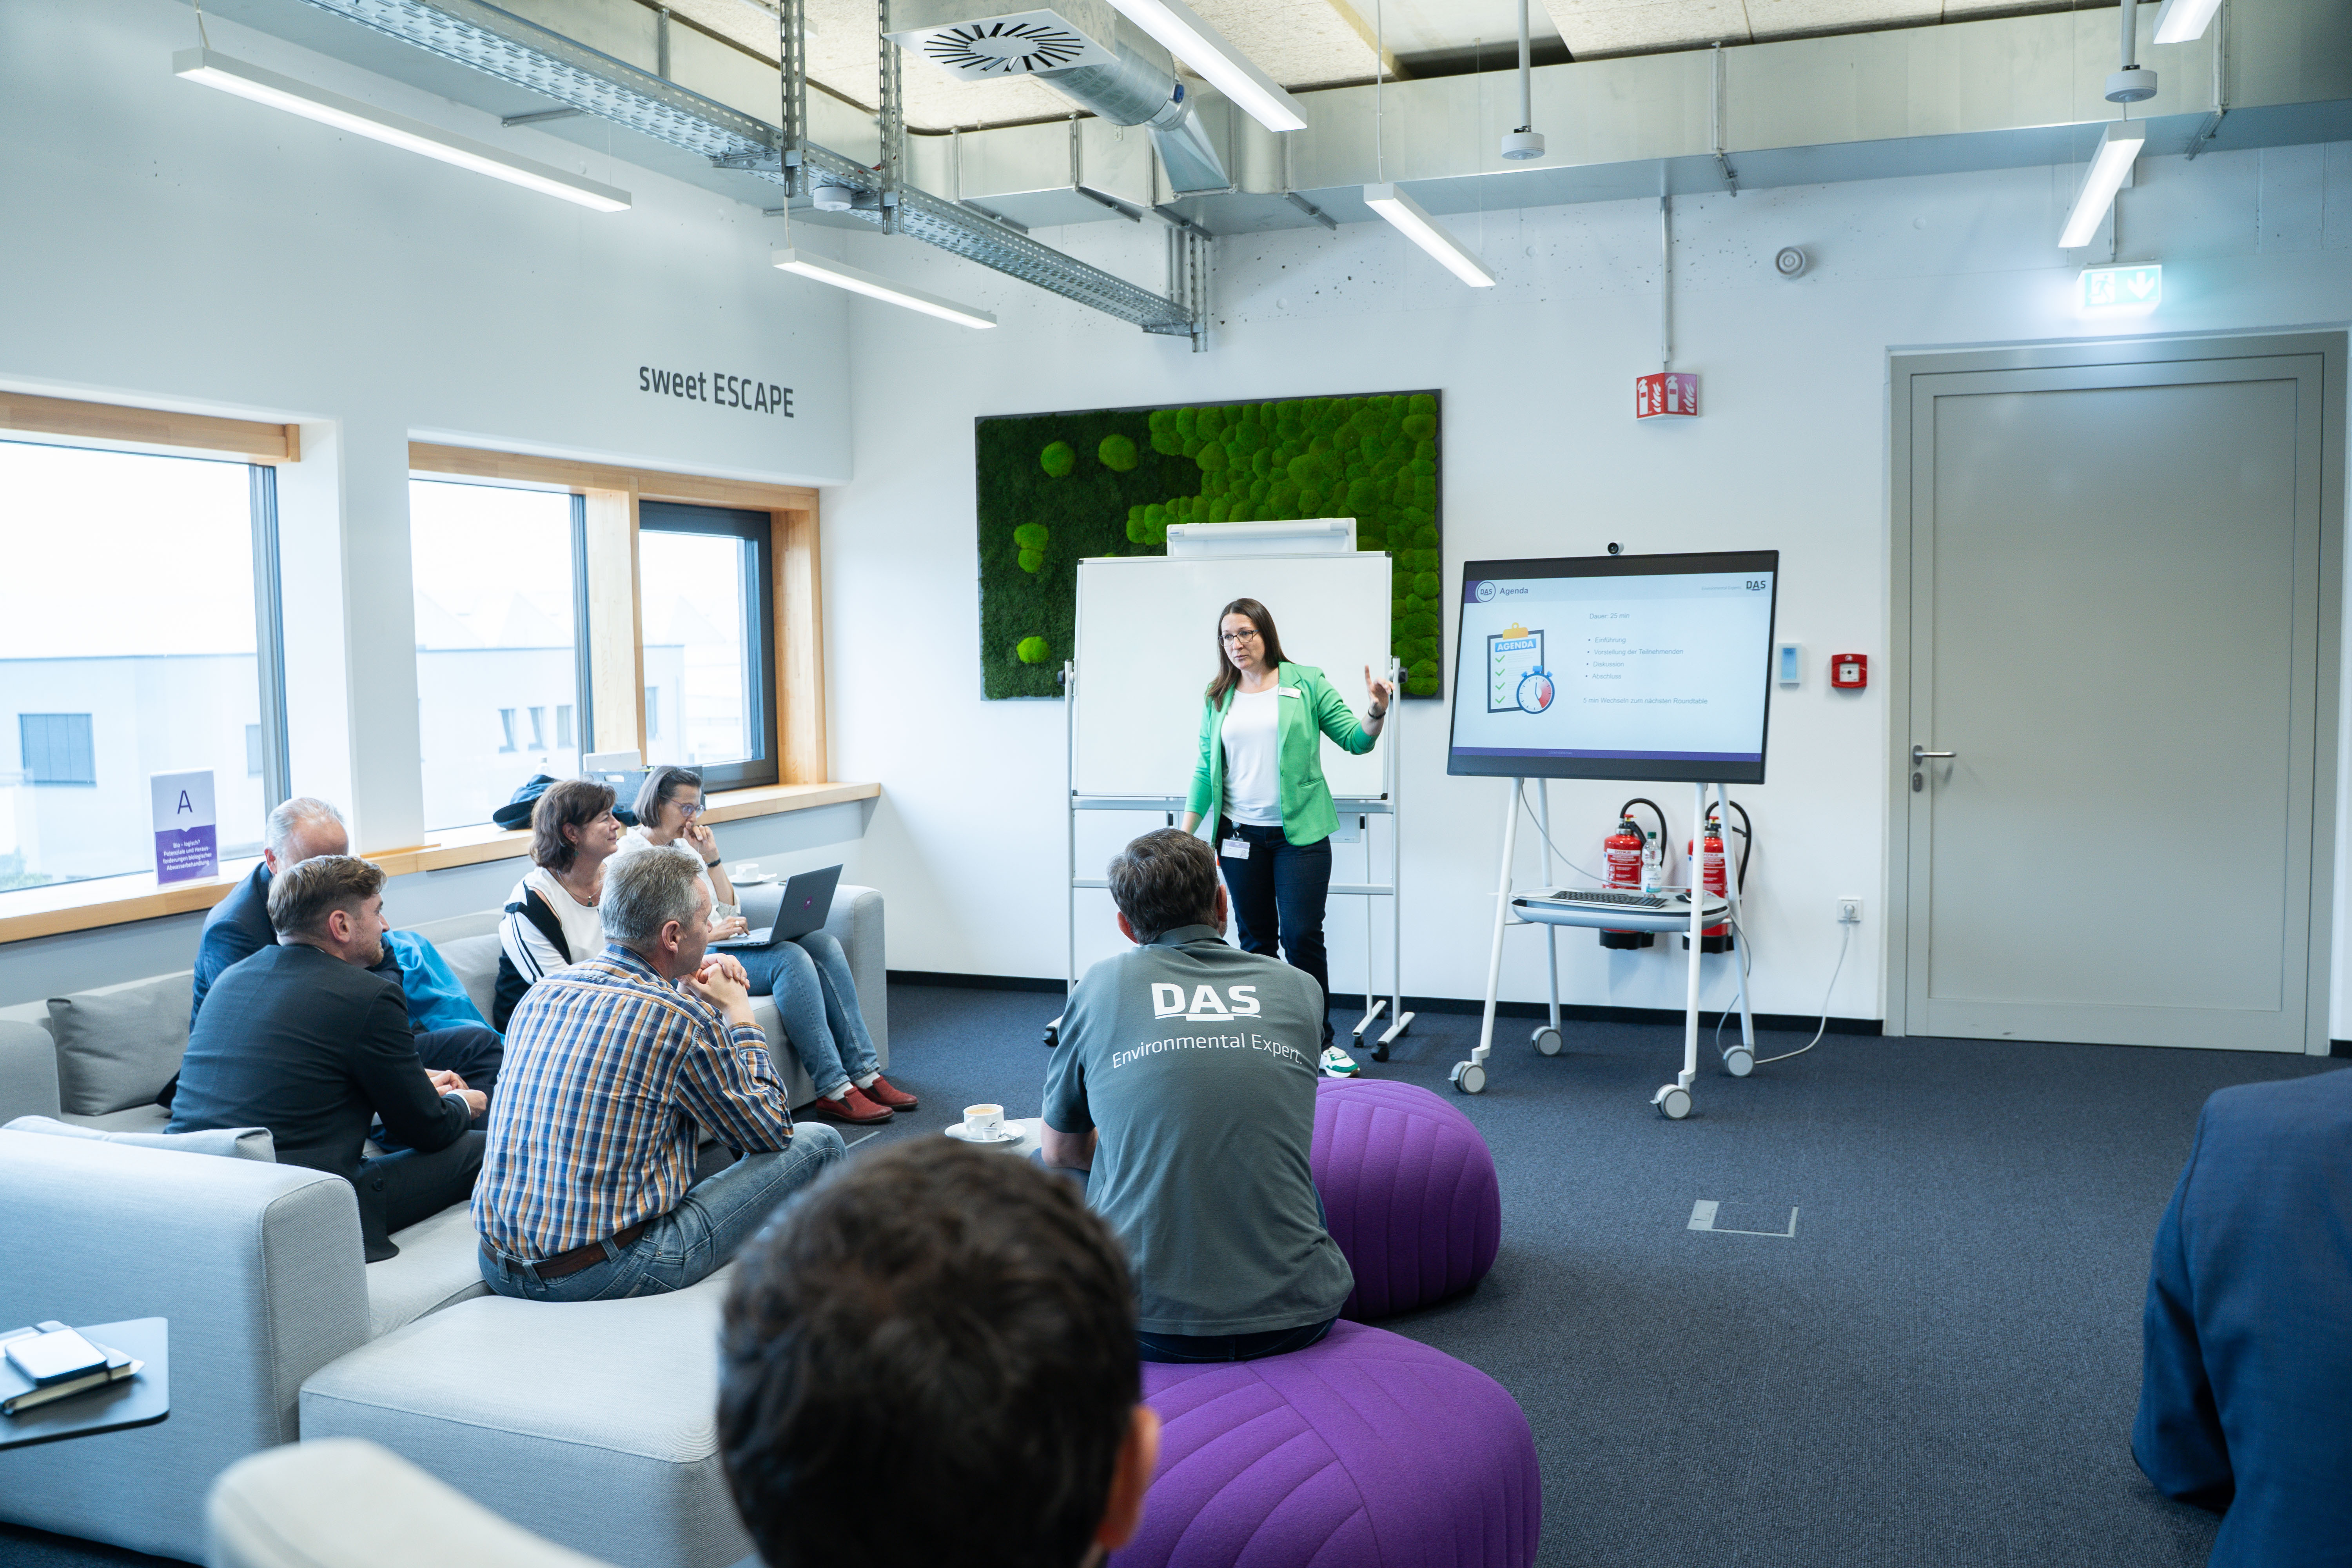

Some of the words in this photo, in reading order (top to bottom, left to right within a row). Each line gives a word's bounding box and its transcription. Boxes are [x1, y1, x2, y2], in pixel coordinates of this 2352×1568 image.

[639, 366, 707, 402] sweet
[713, 372, 794, 418] ESCAPE
[1746, 581, 1766, 589] DAS
[1499, 587, 1528, 596] Agenda
[1497, 640, 1534, 651] AGENDA
[177, 790, 193, 815] A
[183, 839, 201, 848] logisch?
[188, 852, 212, 861] biologischer
[167, 860, 210, 871] Abwasserbehandlung
[1151, 983, 1261, 1018] DAS
[1112, 1033, 1245, 1069] Environmental
[1251, 1034, 1303, 1065] Expert.
